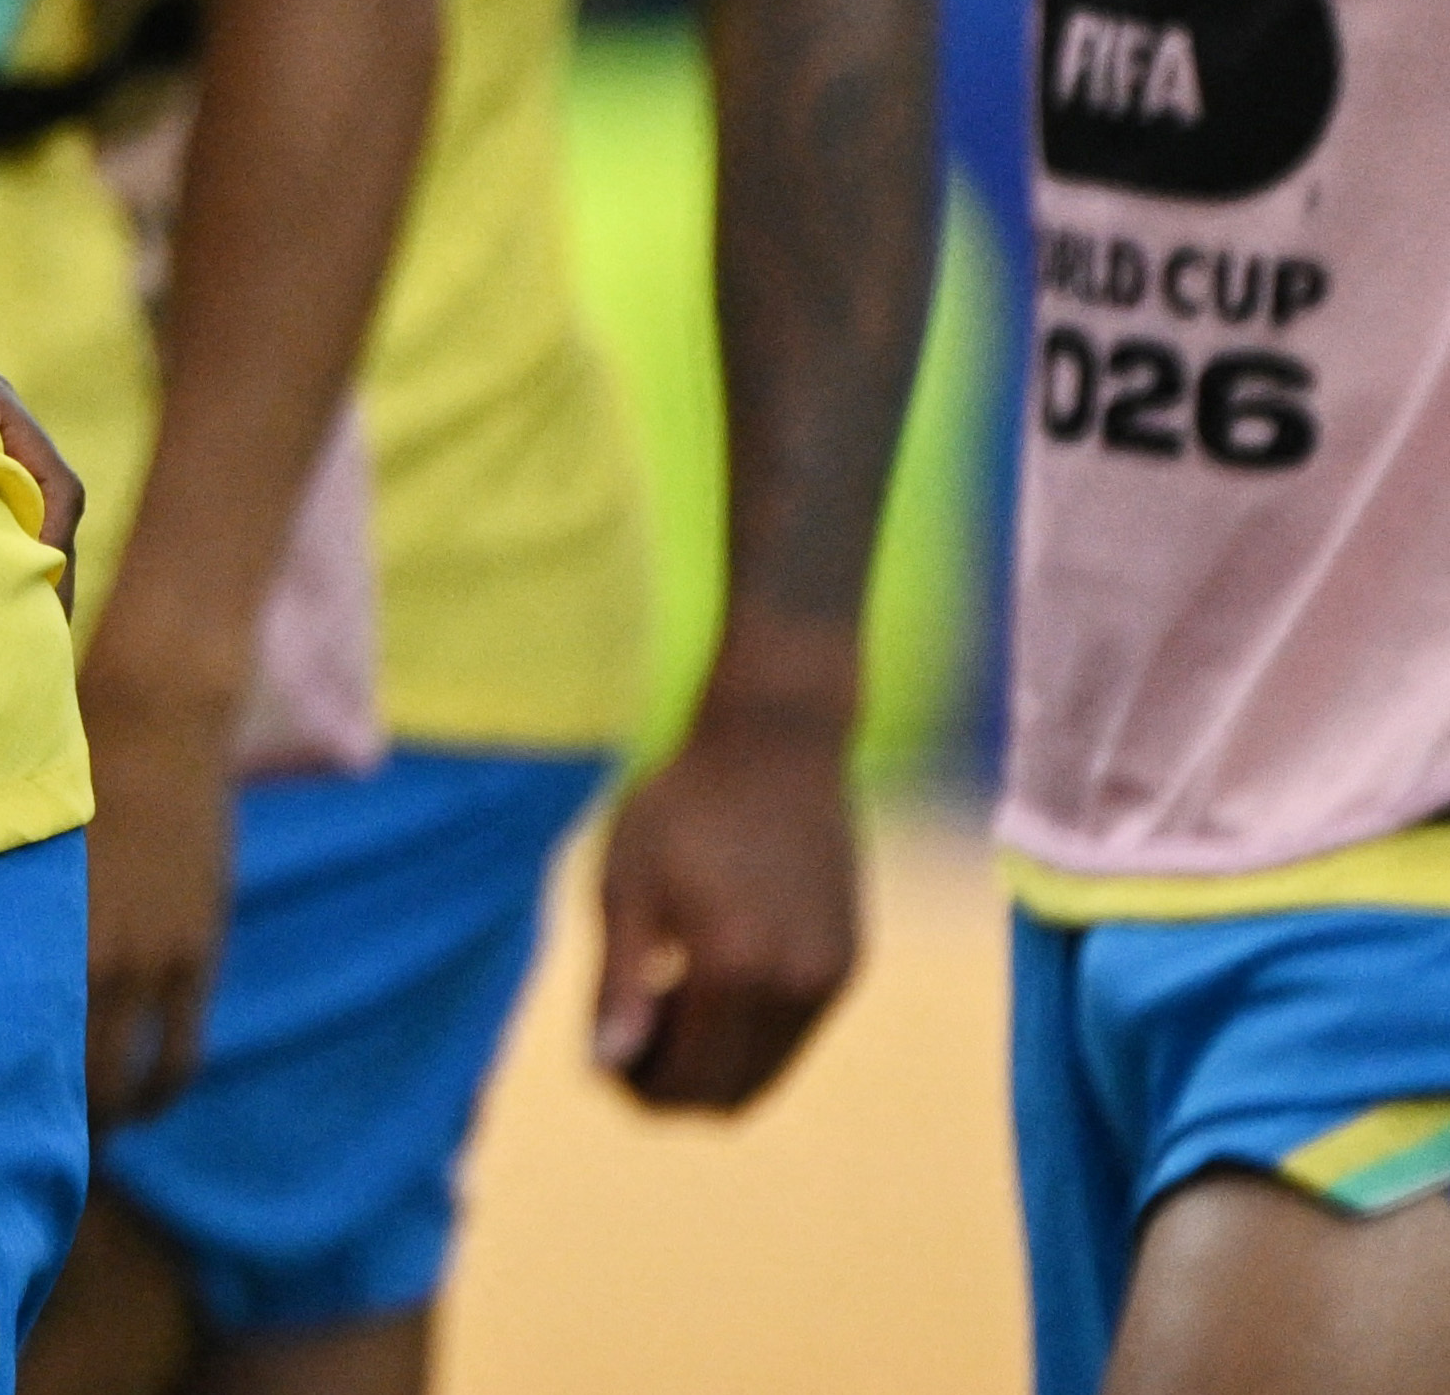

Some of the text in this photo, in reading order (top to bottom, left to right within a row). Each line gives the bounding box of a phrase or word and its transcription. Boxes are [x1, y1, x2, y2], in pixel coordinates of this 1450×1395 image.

[1056, 11, 1205, 125] FIFA
[1162, 245, 1329, 327] CUP
[1042, 325, 1319, 473] 026
